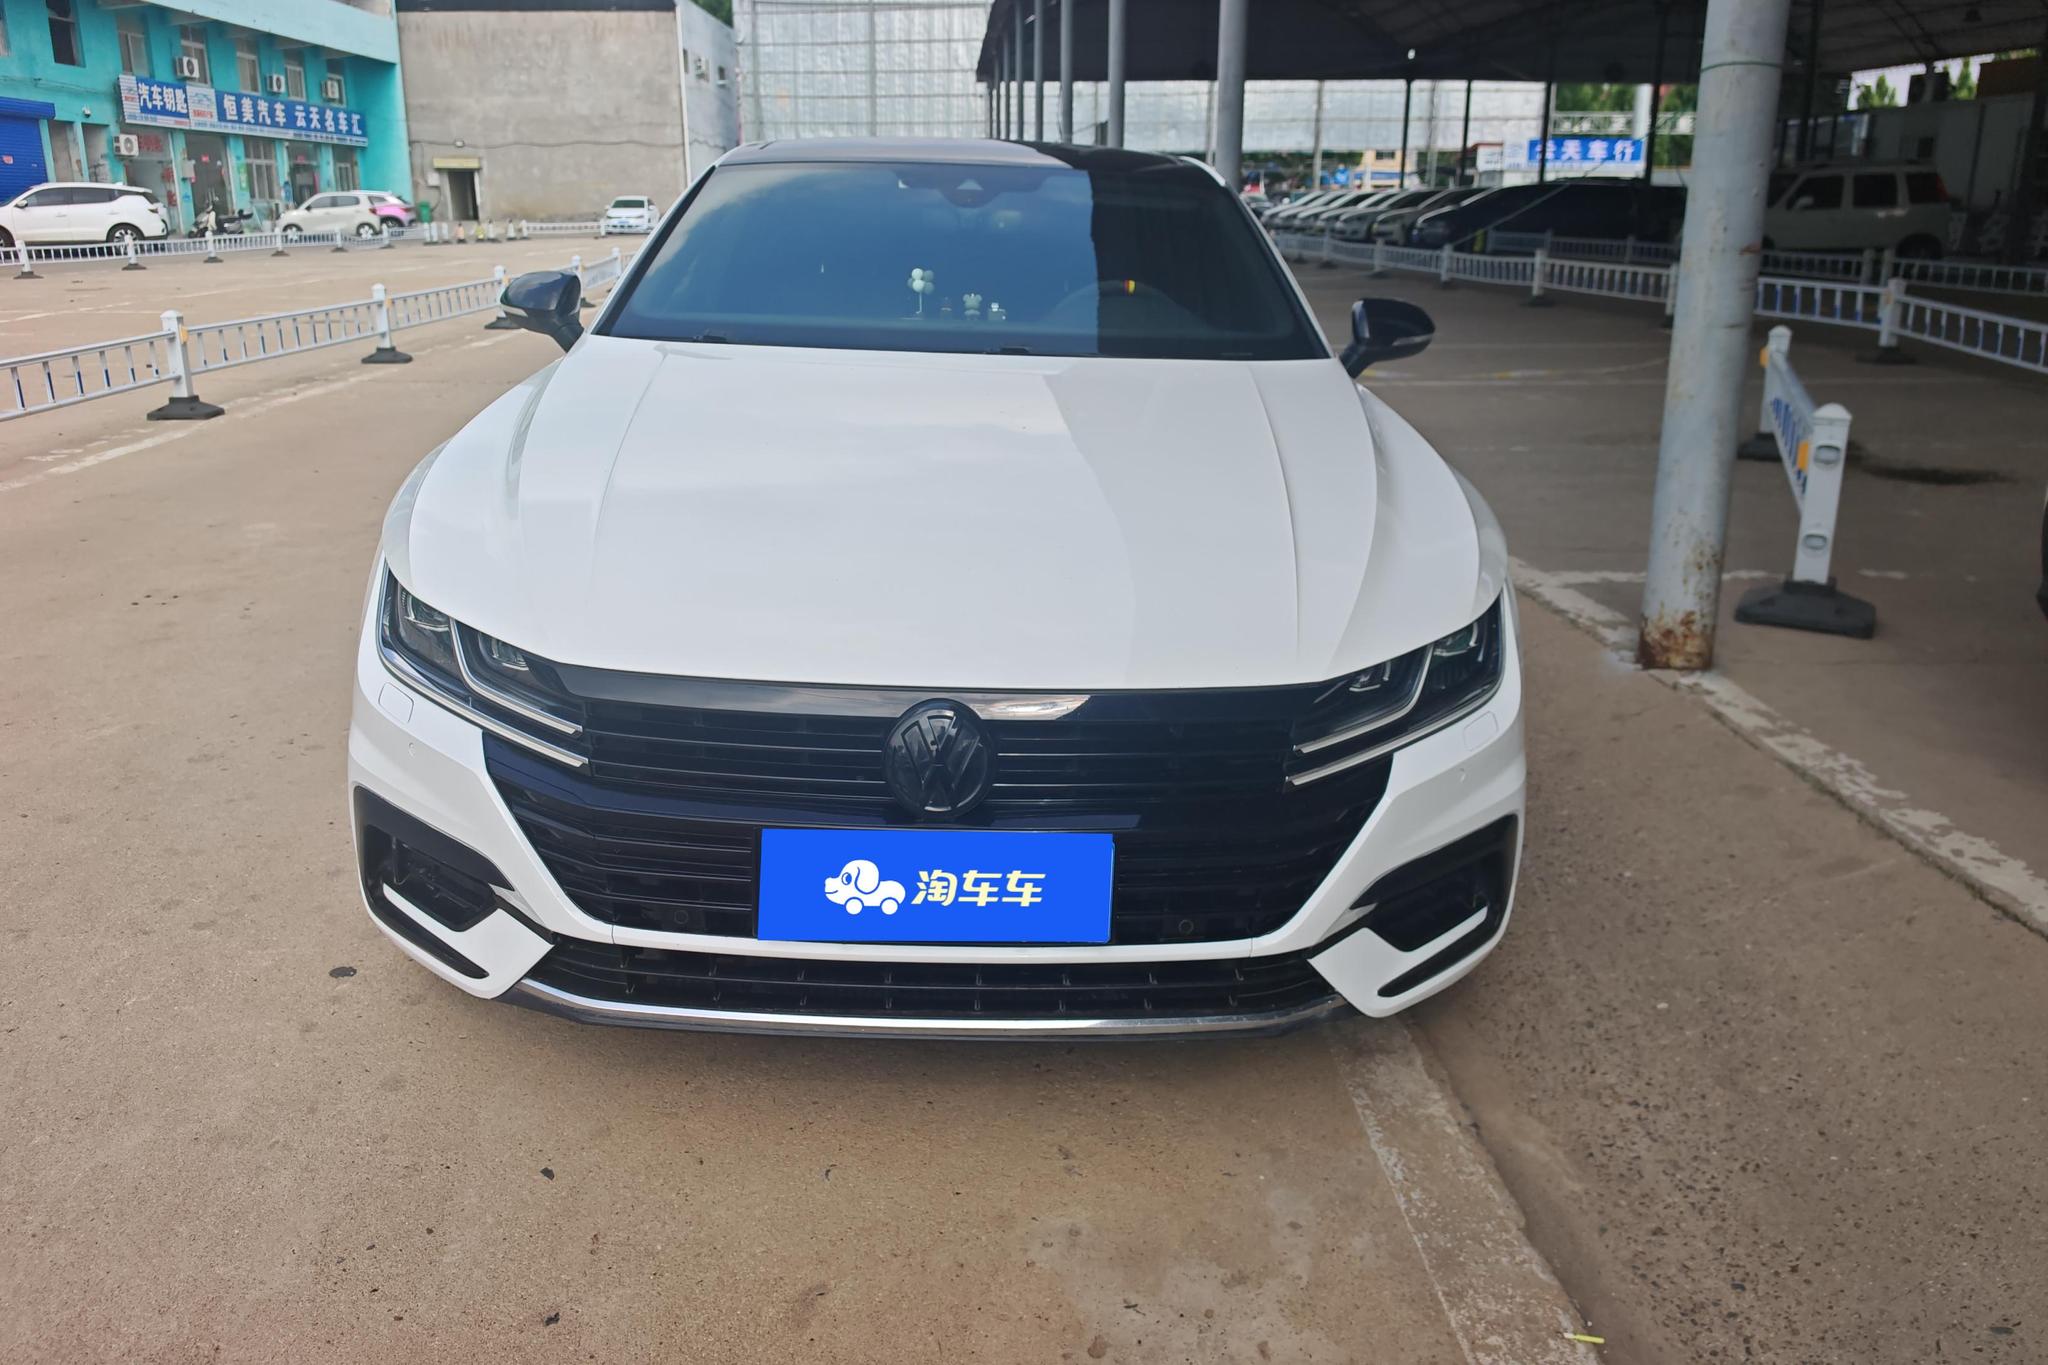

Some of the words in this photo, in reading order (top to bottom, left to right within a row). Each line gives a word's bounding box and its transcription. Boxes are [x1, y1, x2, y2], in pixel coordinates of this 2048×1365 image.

[138, 82, 188, 114] 汽车钥匙
[223, 94, 286, 127] 恒美汽车
[294, 105, 362, 135] 云天名车汇
